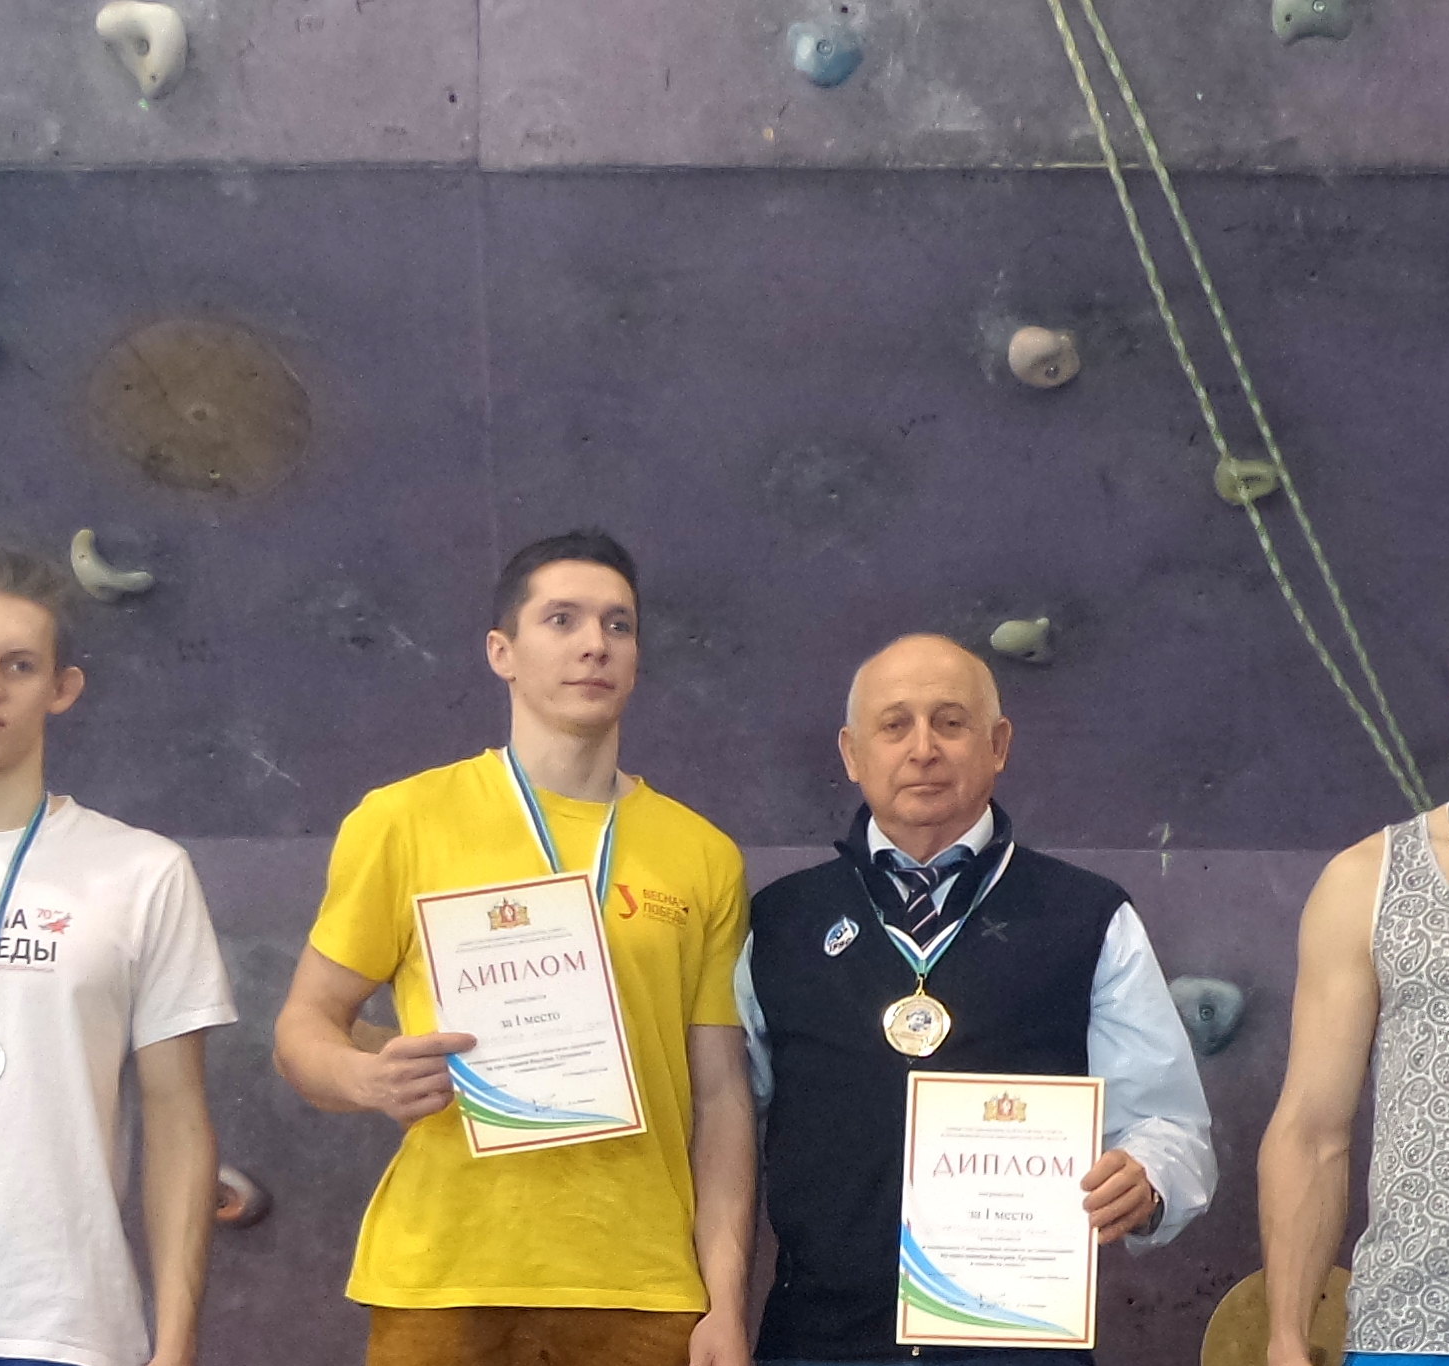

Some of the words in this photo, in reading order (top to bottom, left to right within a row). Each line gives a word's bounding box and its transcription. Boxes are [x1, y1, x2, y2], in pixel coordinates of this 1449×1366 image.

[458, 950, 587, 993] ДИПЛОМ
[524, 1012, 561, 1024] место
[933, 1152, 1074, 1178] ДИПЛОМ
[994, 1211, 1034, 1221] место
